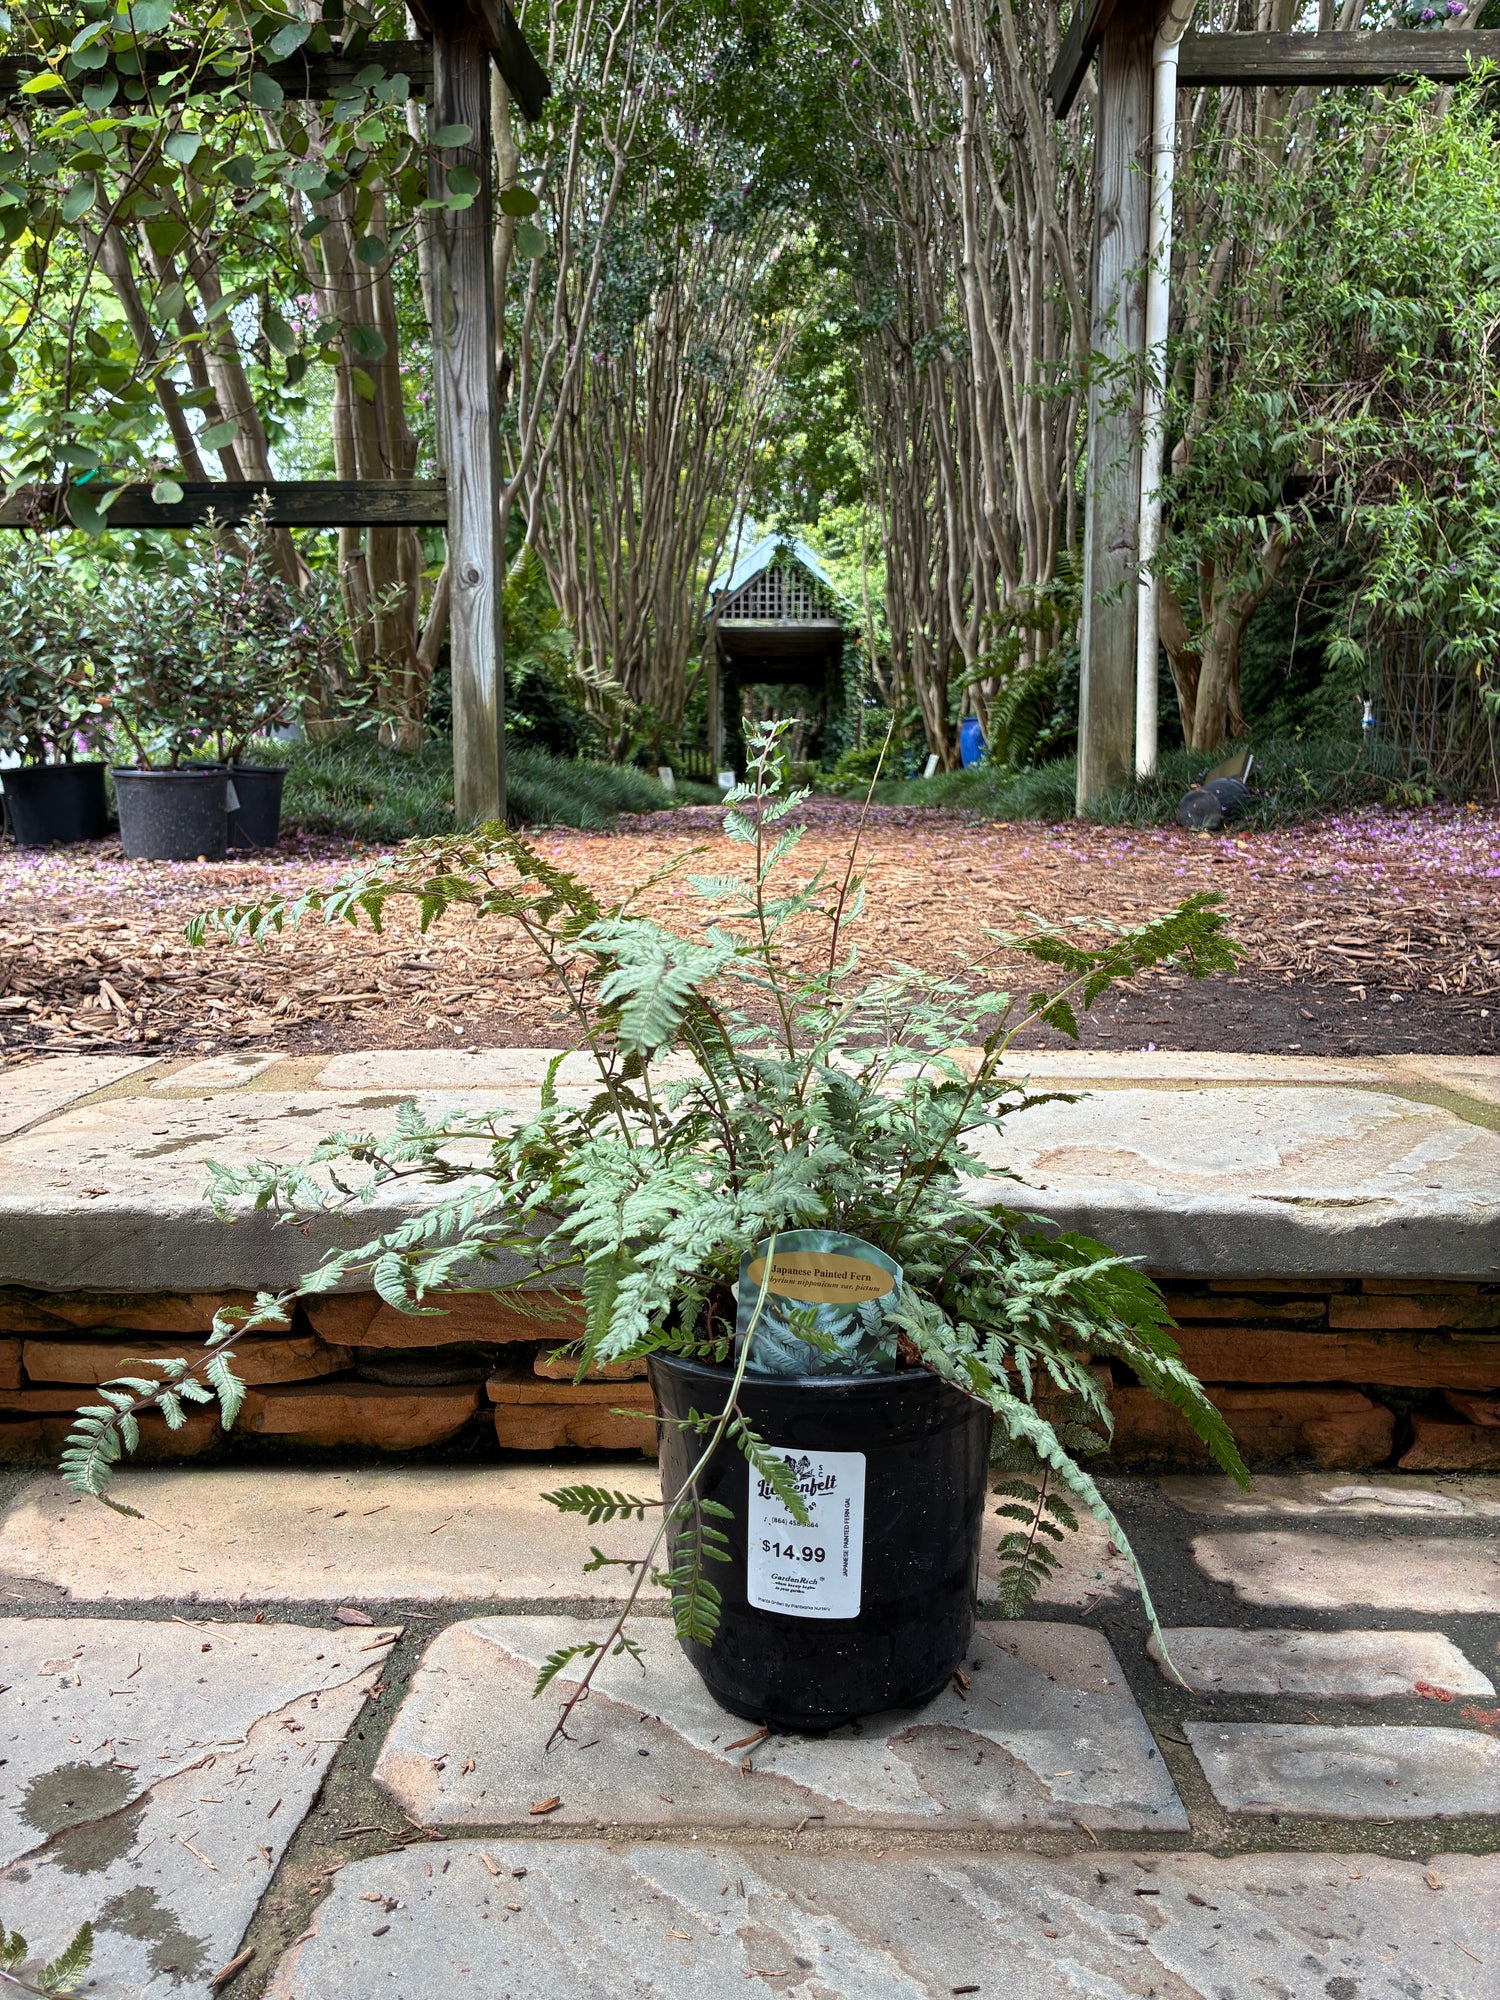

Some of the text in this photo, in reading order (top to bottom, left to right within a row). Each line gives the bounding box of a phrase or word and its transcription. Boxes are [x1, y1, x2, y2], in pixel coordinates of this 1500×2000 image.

[771, 1264, 872, 1281] Japanese Painted Fern
[797, 1279, 839, 1289] nipponicum
[855, 1284, 880, 1292] pictum
[772, 1517, 788, 1527] (864)
[762, 1539, 826, 1563] $14.99
